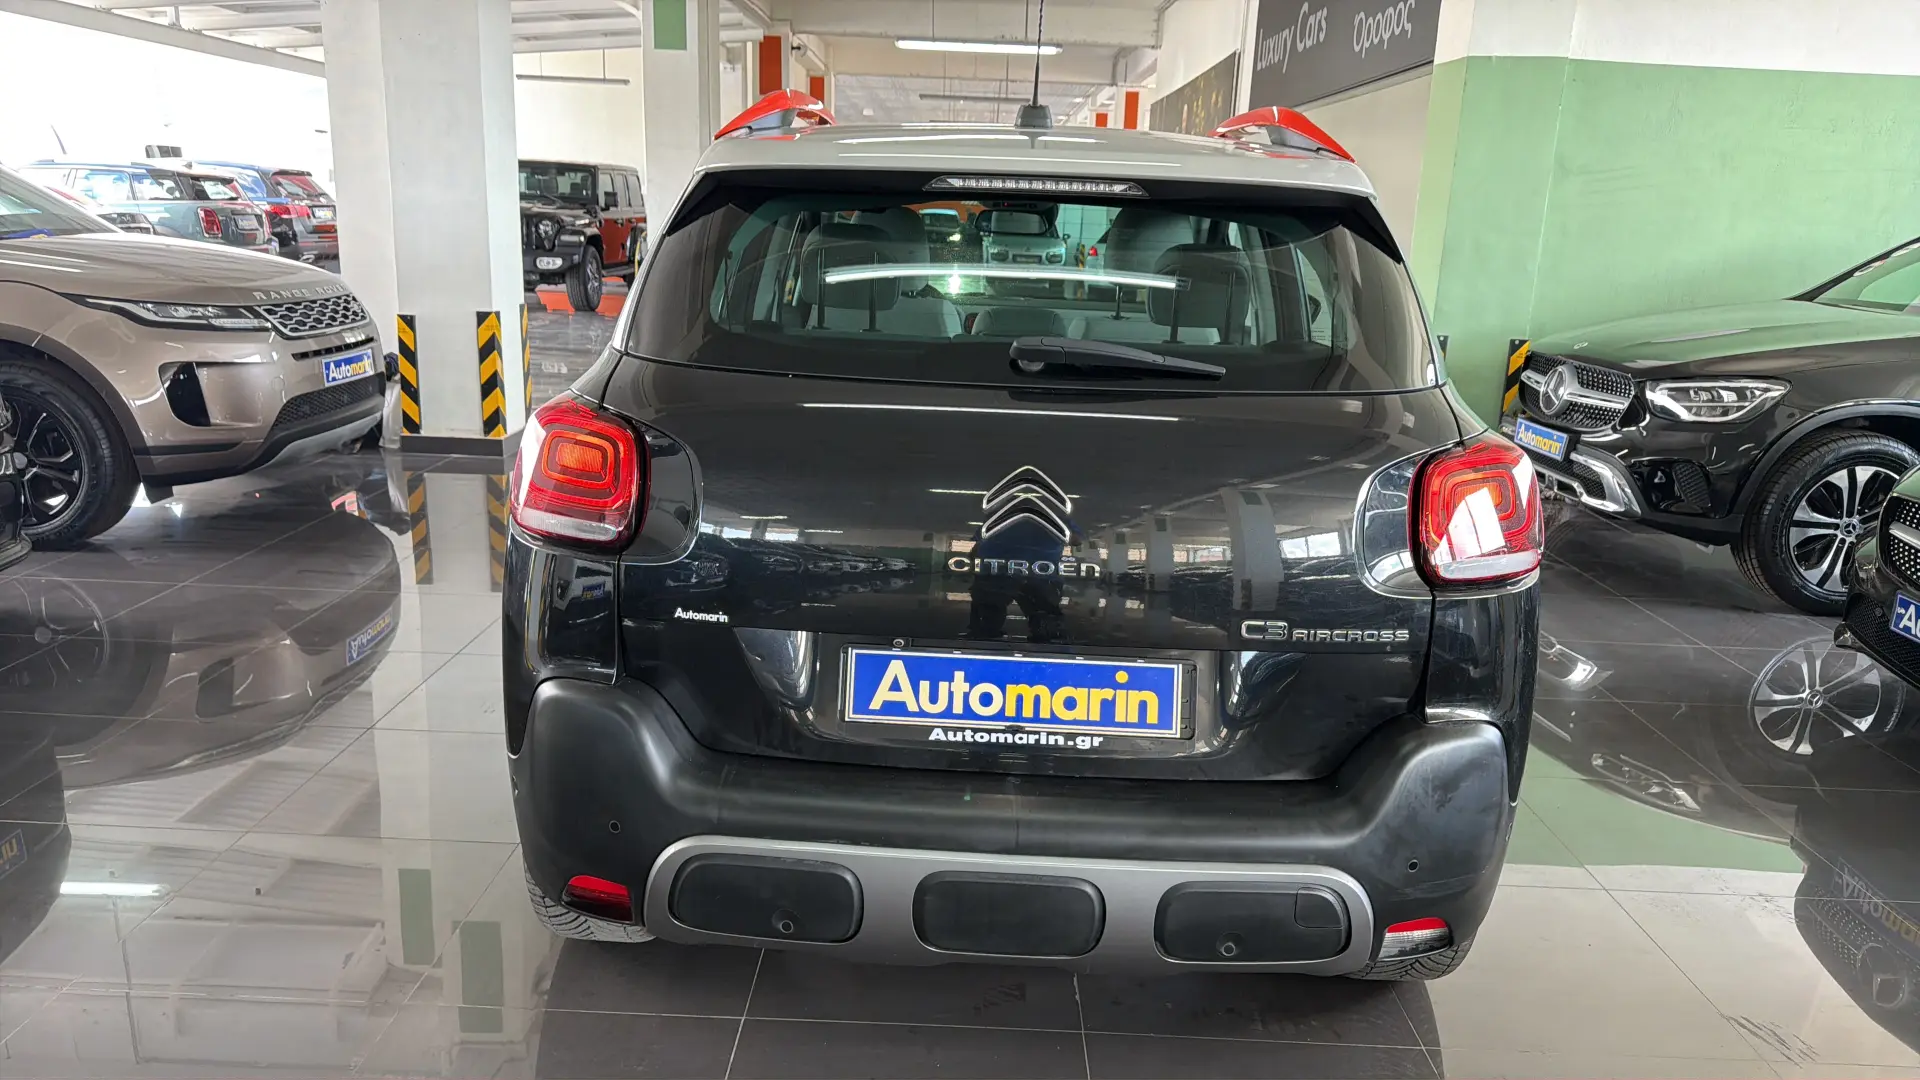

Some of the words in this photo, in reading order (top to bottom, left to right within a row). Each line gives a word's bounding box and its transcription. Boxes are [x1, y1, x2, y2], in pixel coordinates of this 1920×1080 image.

[1257, 25, 1295, 74] Luxury
[1296, 2, 1328, 53] Cars
[252, 287, 312, 301] RANGE
[1517, 423, 1562, 455] Automarin
[674, 607, 728, 623] Automarin
[1241, 620, 1288, 640] C3
[1292, 629, 1410, 642] AIRCROSS
[868, 659, 1159, 724] Automarin
[928, 728, 1104, 750] Automarin.gr
